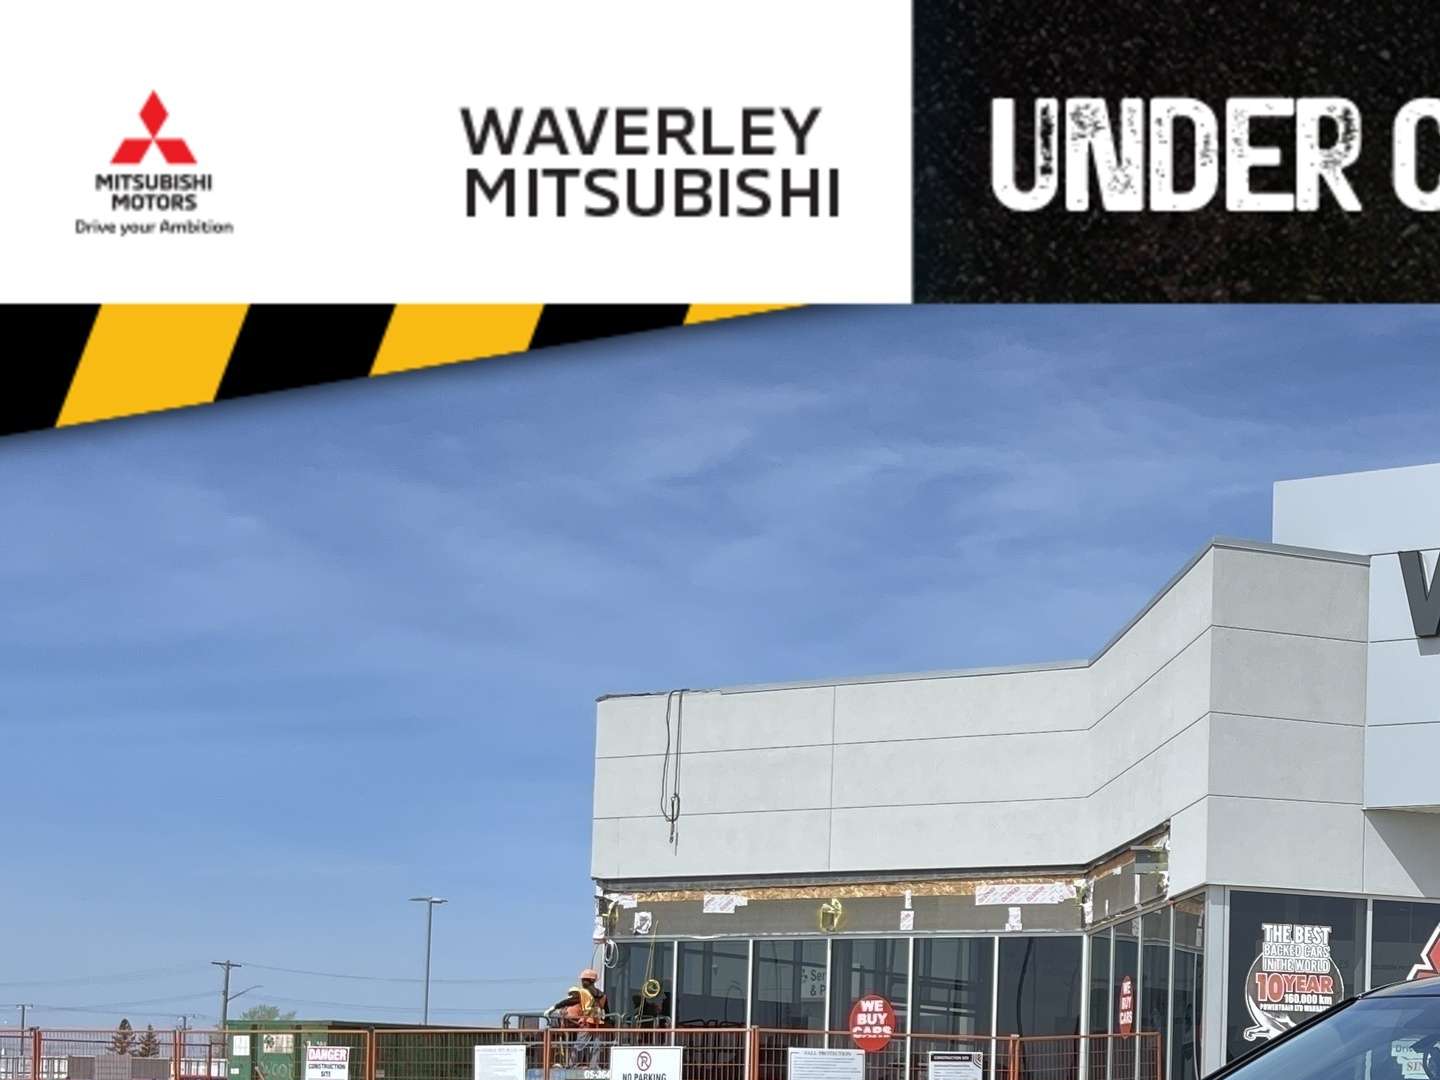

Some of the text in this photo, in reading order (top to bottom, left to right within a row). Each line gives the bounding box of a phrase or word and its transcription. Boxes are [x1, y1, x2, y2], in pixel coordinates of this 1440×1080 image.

[1262, 923, 1332, 946] THE BEST
[1263, 943, 1331, 959] BACKED CARS
[1263, 958, 1331, 973] IN THE WORLD
[1256, 973, 1333, 1002] 10 YEAR
[861, 1000, 884, 1012] WE
[1319, 995, 1332, 1005] km
[857, 1013, 888, 1025] BUY
[308, 1048, 347, 1061] DANGER
